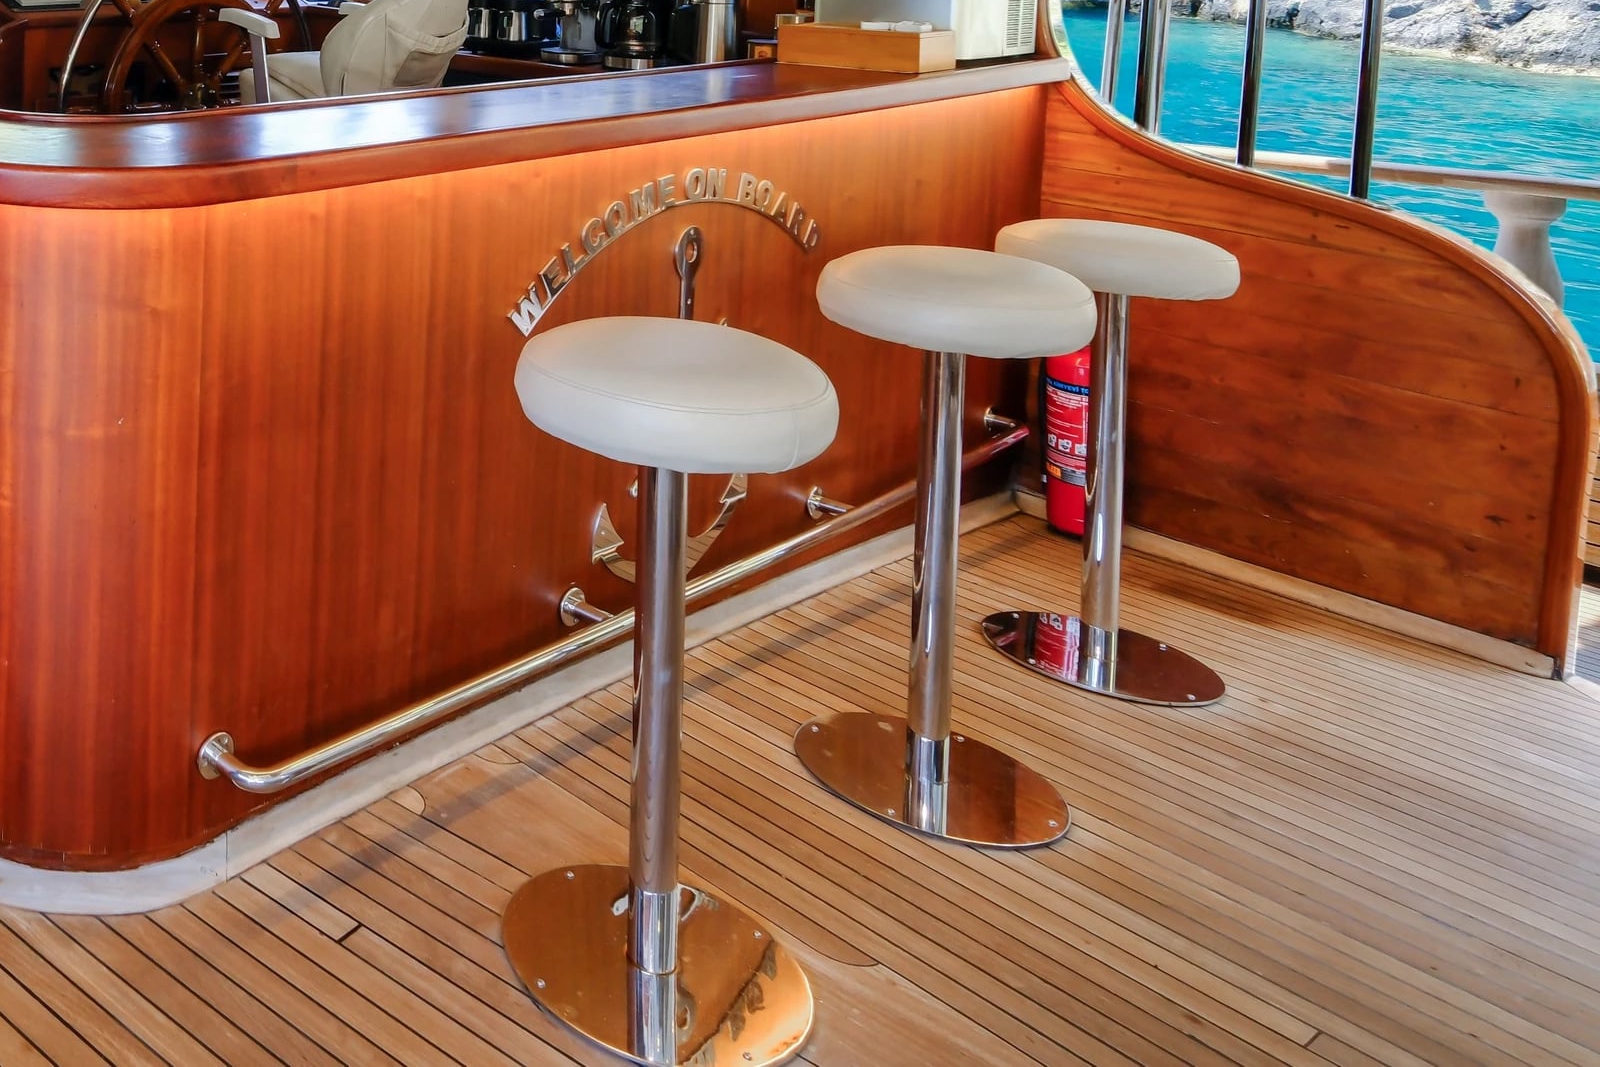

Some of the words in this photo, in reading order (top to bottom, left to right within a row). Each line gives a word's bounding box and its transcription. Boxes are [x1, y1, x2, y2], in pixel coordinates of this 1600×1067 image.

[506, 173, 677, 337] WELCOME
[684, 167, 728, 201] ON
[736, 172, 822, 253] BOARD
